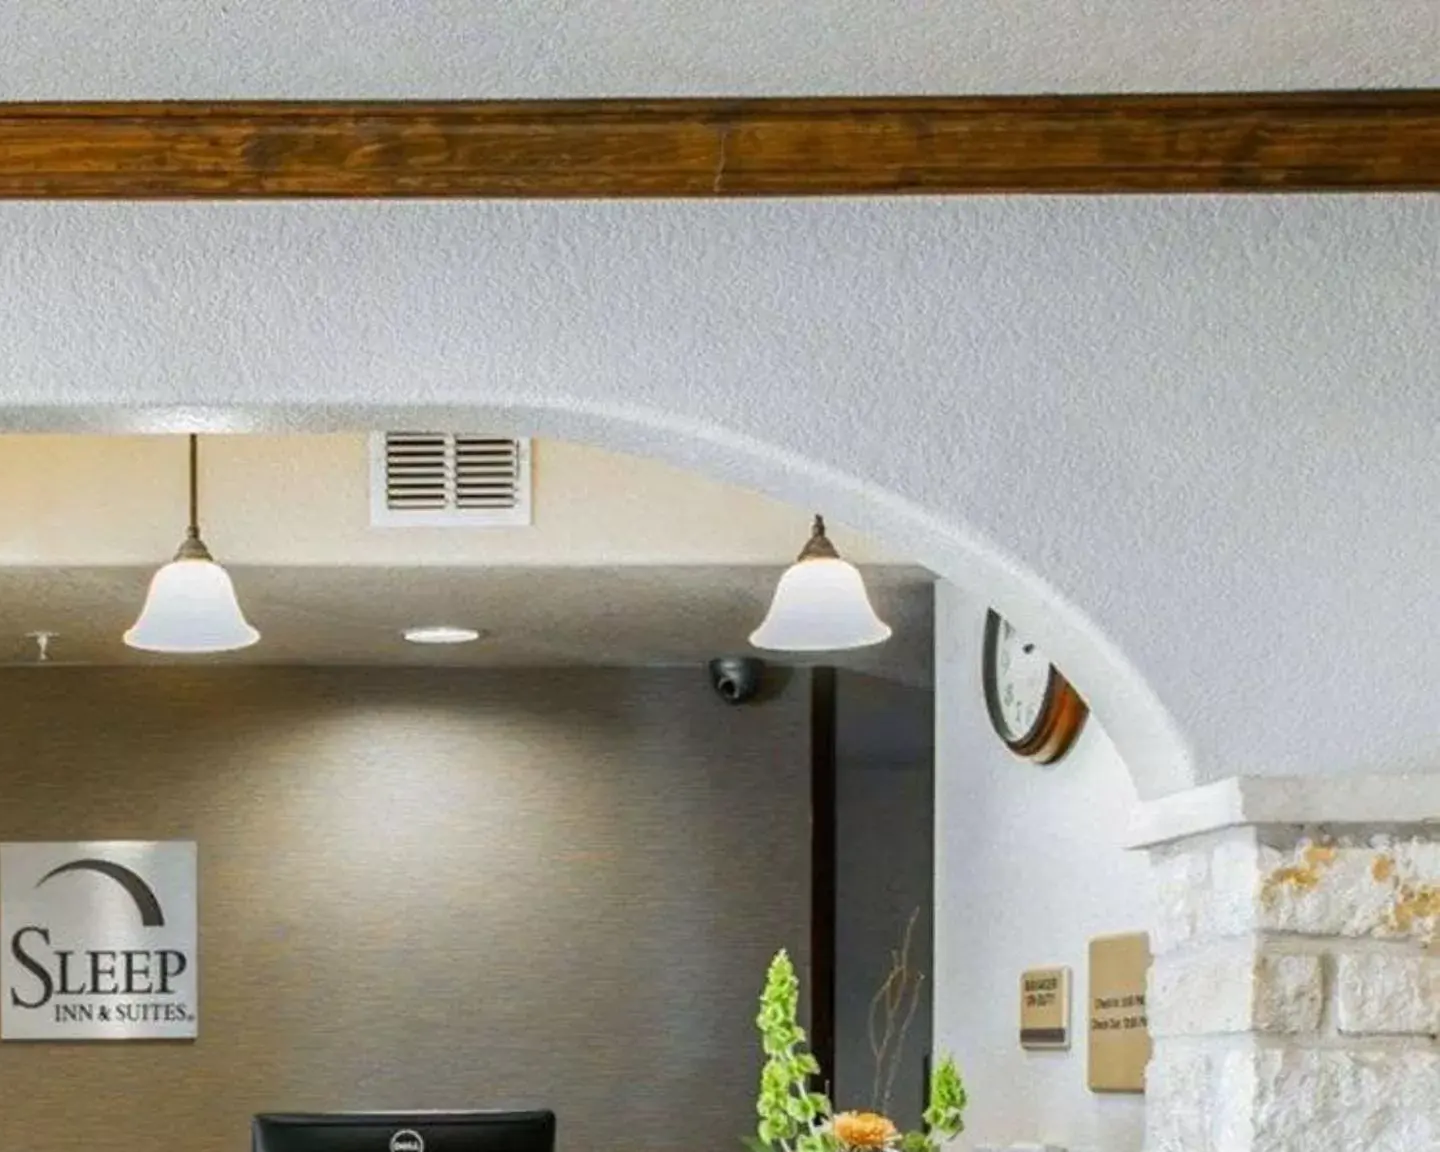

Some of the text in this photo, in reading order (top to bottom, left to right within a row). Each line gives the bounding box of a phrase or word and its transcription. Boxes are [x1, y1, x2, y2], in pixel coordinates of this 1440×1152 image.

[11, 926, 187, 1009] SLEEP
[55, 1003, 93, 1023] INN
[98, 1004, 111, 1022] &
[394, 1141, 419, 1151] DELL
